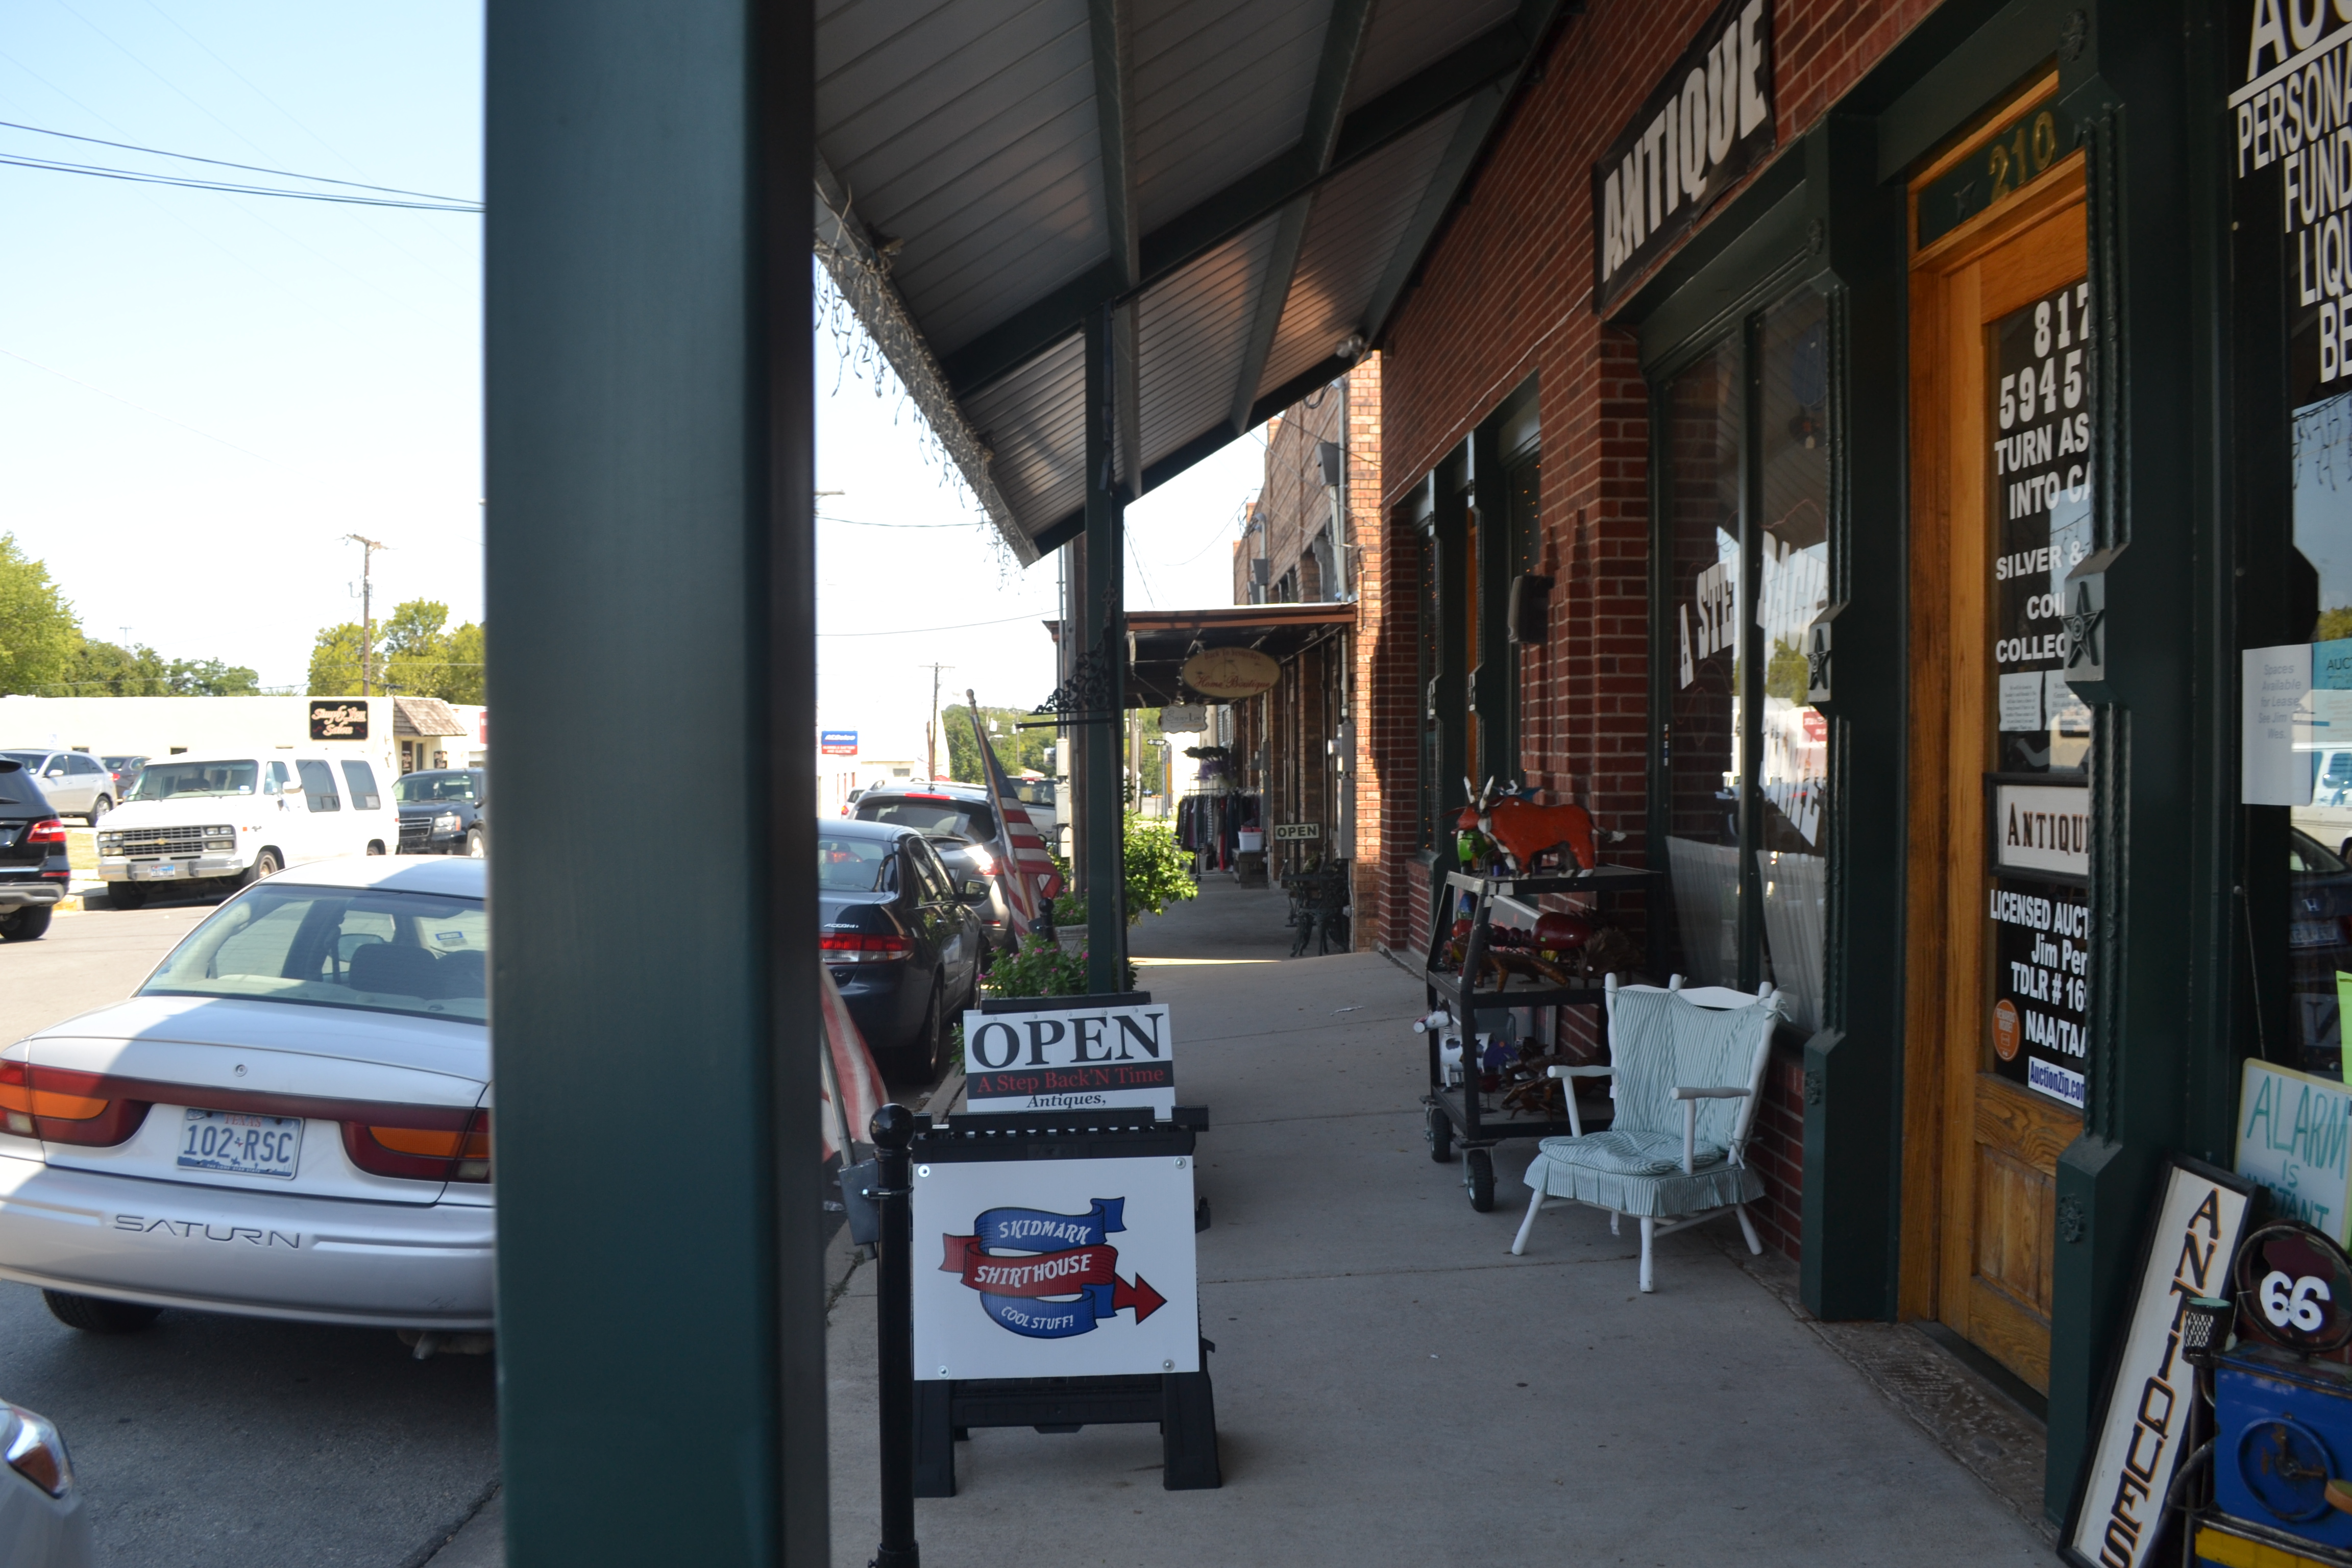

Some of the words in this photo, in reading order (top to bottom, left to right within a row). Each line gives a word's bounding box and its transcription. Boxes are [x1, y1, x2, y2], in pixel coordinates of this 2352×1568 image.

[2247, 0, 2352, 82] AU
[1603, 0, 1768, 282] ANTIQUE
[1988, 111, 2059, 204] 210
[2035, 282, 2089, 357] 817
[1999, 349, 2090, 430] 5945
[1994, 424, 2052, 475] TURN
[2010, 472, 2060, 520] INTO
[1996, 545, 2062, 580] SILVER
[1680, 603, 1694, 690] A
[1697, 549, 1739, 660] STE
[2264, 664, 2294, 676] Spaces
[2326, 657, 2352, 670] AUC
[1193, 675, 1223, 688] Home
[1226, 675, 1270, 692] Boutique
[2262, 679, 2301, 691] Available
[2258, 713, 2271, 723] See
[2272, 713, 2287, 723] Jim
[2261, 697, 2270, 707] for
[2272, 696, 2300, 706] Lease
[1277, 825, 1317, 838] OPEN
[1990, 889, 2051, 930] LICENSED
[2031, 933, 2057, 968] Jim
[2011, 961, 2049, 1001] TDLR
[2052, 973, 2062, 1005] #
[2066, 976, 2087, 1012] 16
[972, 1013, 1164, 1069] OPEN
[977, 1076, 993, 1093] A
[996, 1074, 1039, 1094] Step
[1115, 1066, 1164, 1084] Time
[1026, 1094, 1107, 1109] Antiques,
[224, 1113, 263, 1128] TEXAS
[2247, 1075, 2350, 1180] ALARM
[184, 1124, 234, 1158] 102
[242, 1129, 293, 1163] RSC
[2282, 1159, 2300, 1188] IS
[2247, 1173, 2329, 1230] STANT
[113, 1214, 301, 1249] SATURN
[998, 1220, 1092, 1245] SKIDMARK
[974, 1254, 1093, 1288] SHIRTHOUSE
[1001, 1306, 1030, 1327] COOL
[1031, 1314, 1074, 1330] STUFF!
[2260, 1270, 2331, 1332] 66
[2099, 1188, 2221, 1568] ANTIQUES
